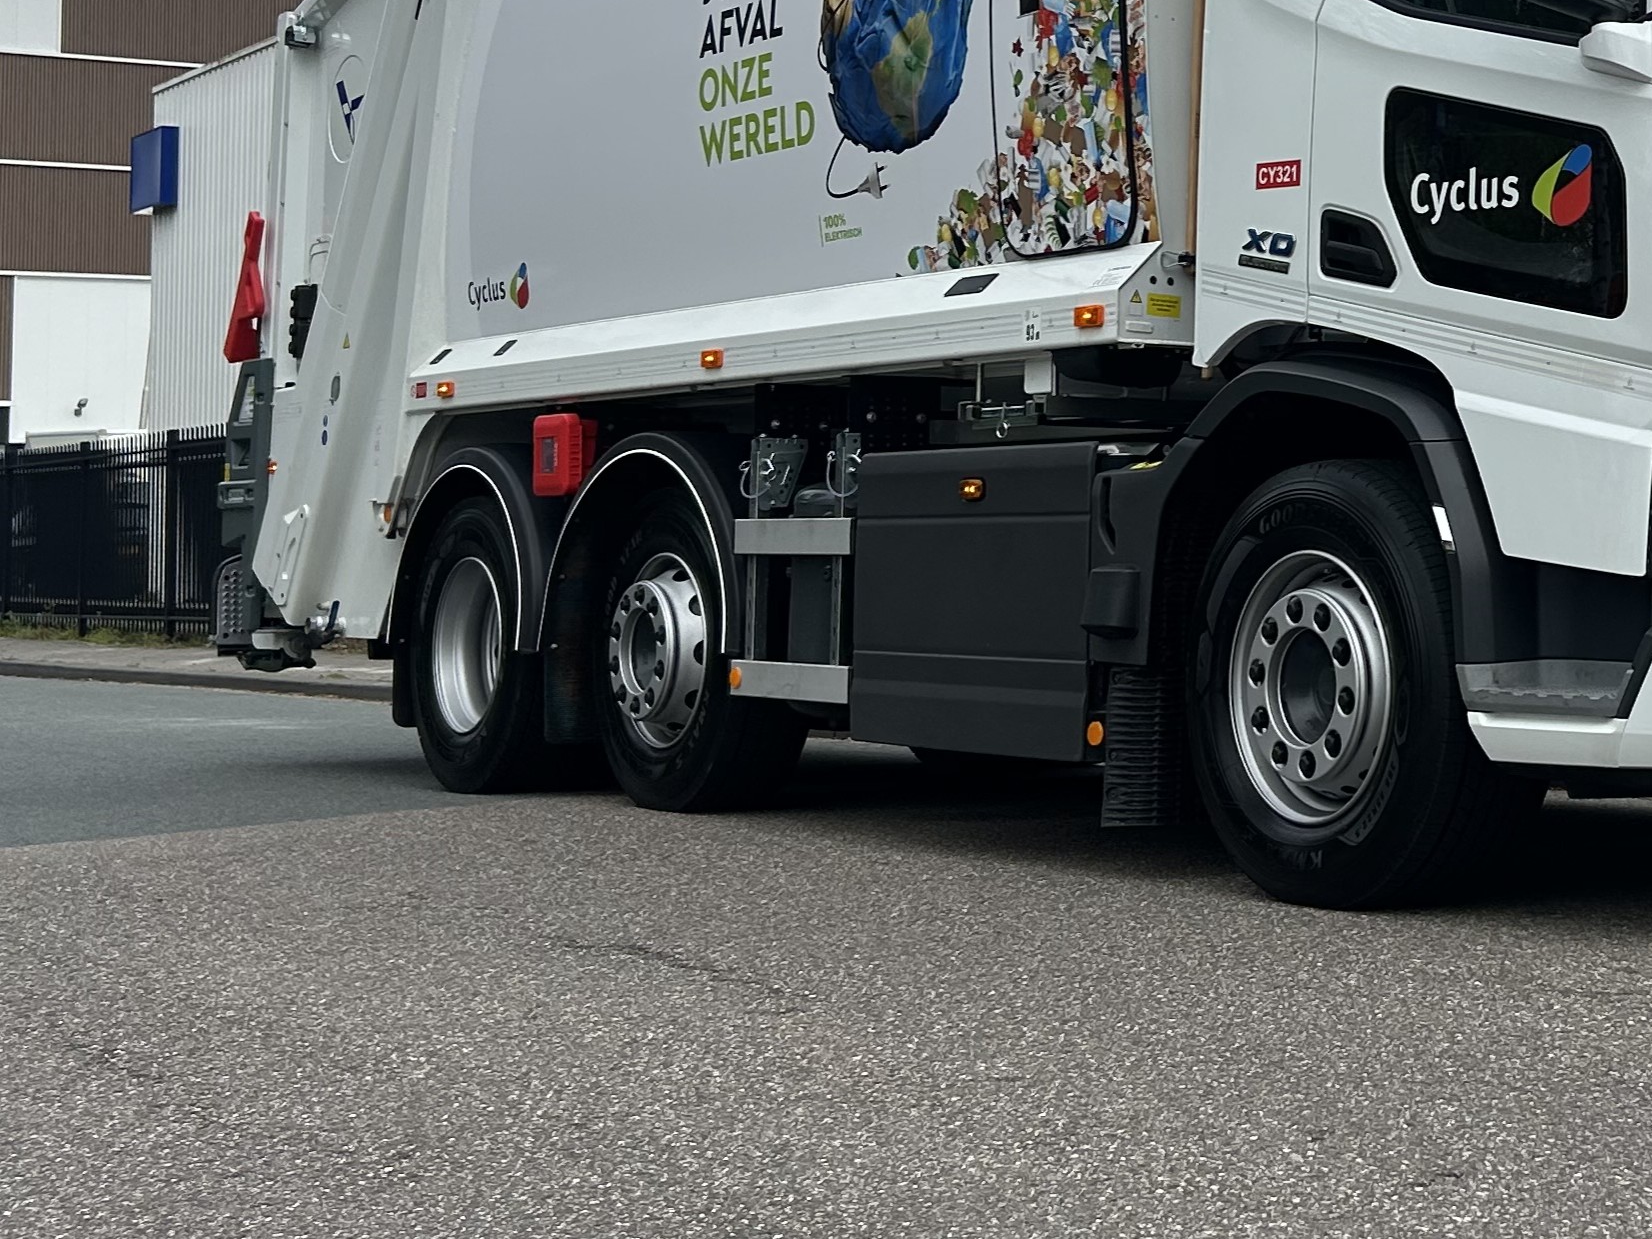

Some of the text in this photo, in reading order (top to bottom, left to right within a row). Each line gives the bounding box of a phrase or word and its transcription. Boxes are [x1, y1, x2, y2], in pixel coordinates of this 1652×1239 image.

[699, 52, 773, 112] ONZE
[699, 100, 815, 167] WERELD
[1258, 165, 1297, 185] CY321
[1410, 166, 1520, 225] Cyclus
[823, 213, 846, 229] 100%
[1241, 228, 1297, 258] XD
[468, 276, 506, 311] Cyclus
